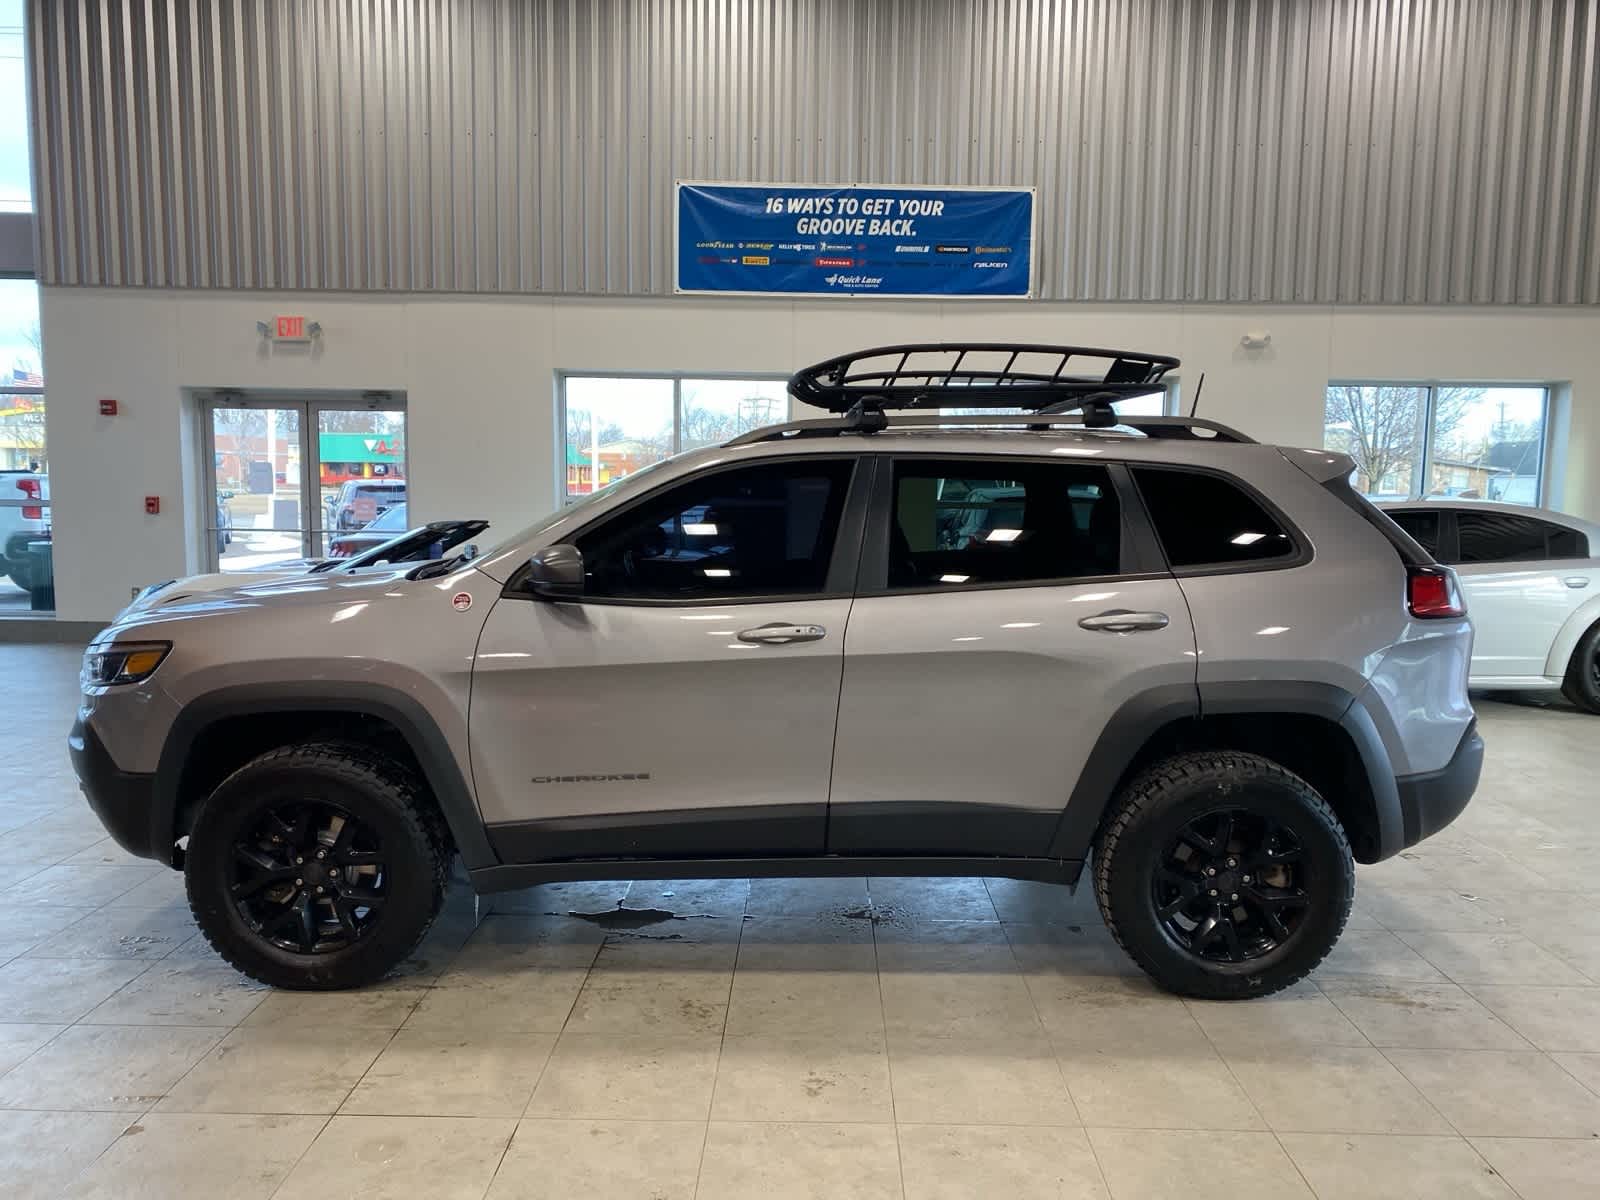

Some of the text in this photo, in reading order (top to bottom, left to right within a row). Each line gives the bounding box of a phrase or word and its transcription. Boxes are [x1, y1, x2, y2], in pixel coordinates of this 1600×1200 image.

[766, 198, 945, 216] 16 WAYS TO GET YOUR
[796, 218, 917, 236] GROOVE BACK.
[696, 241, 734, 249] GOODYEAR
[838, 275, 882, 284] Quick Lane
[278, 317, 304, 337] EXIT
[531, 774, 650, 784] CHEROKEE
